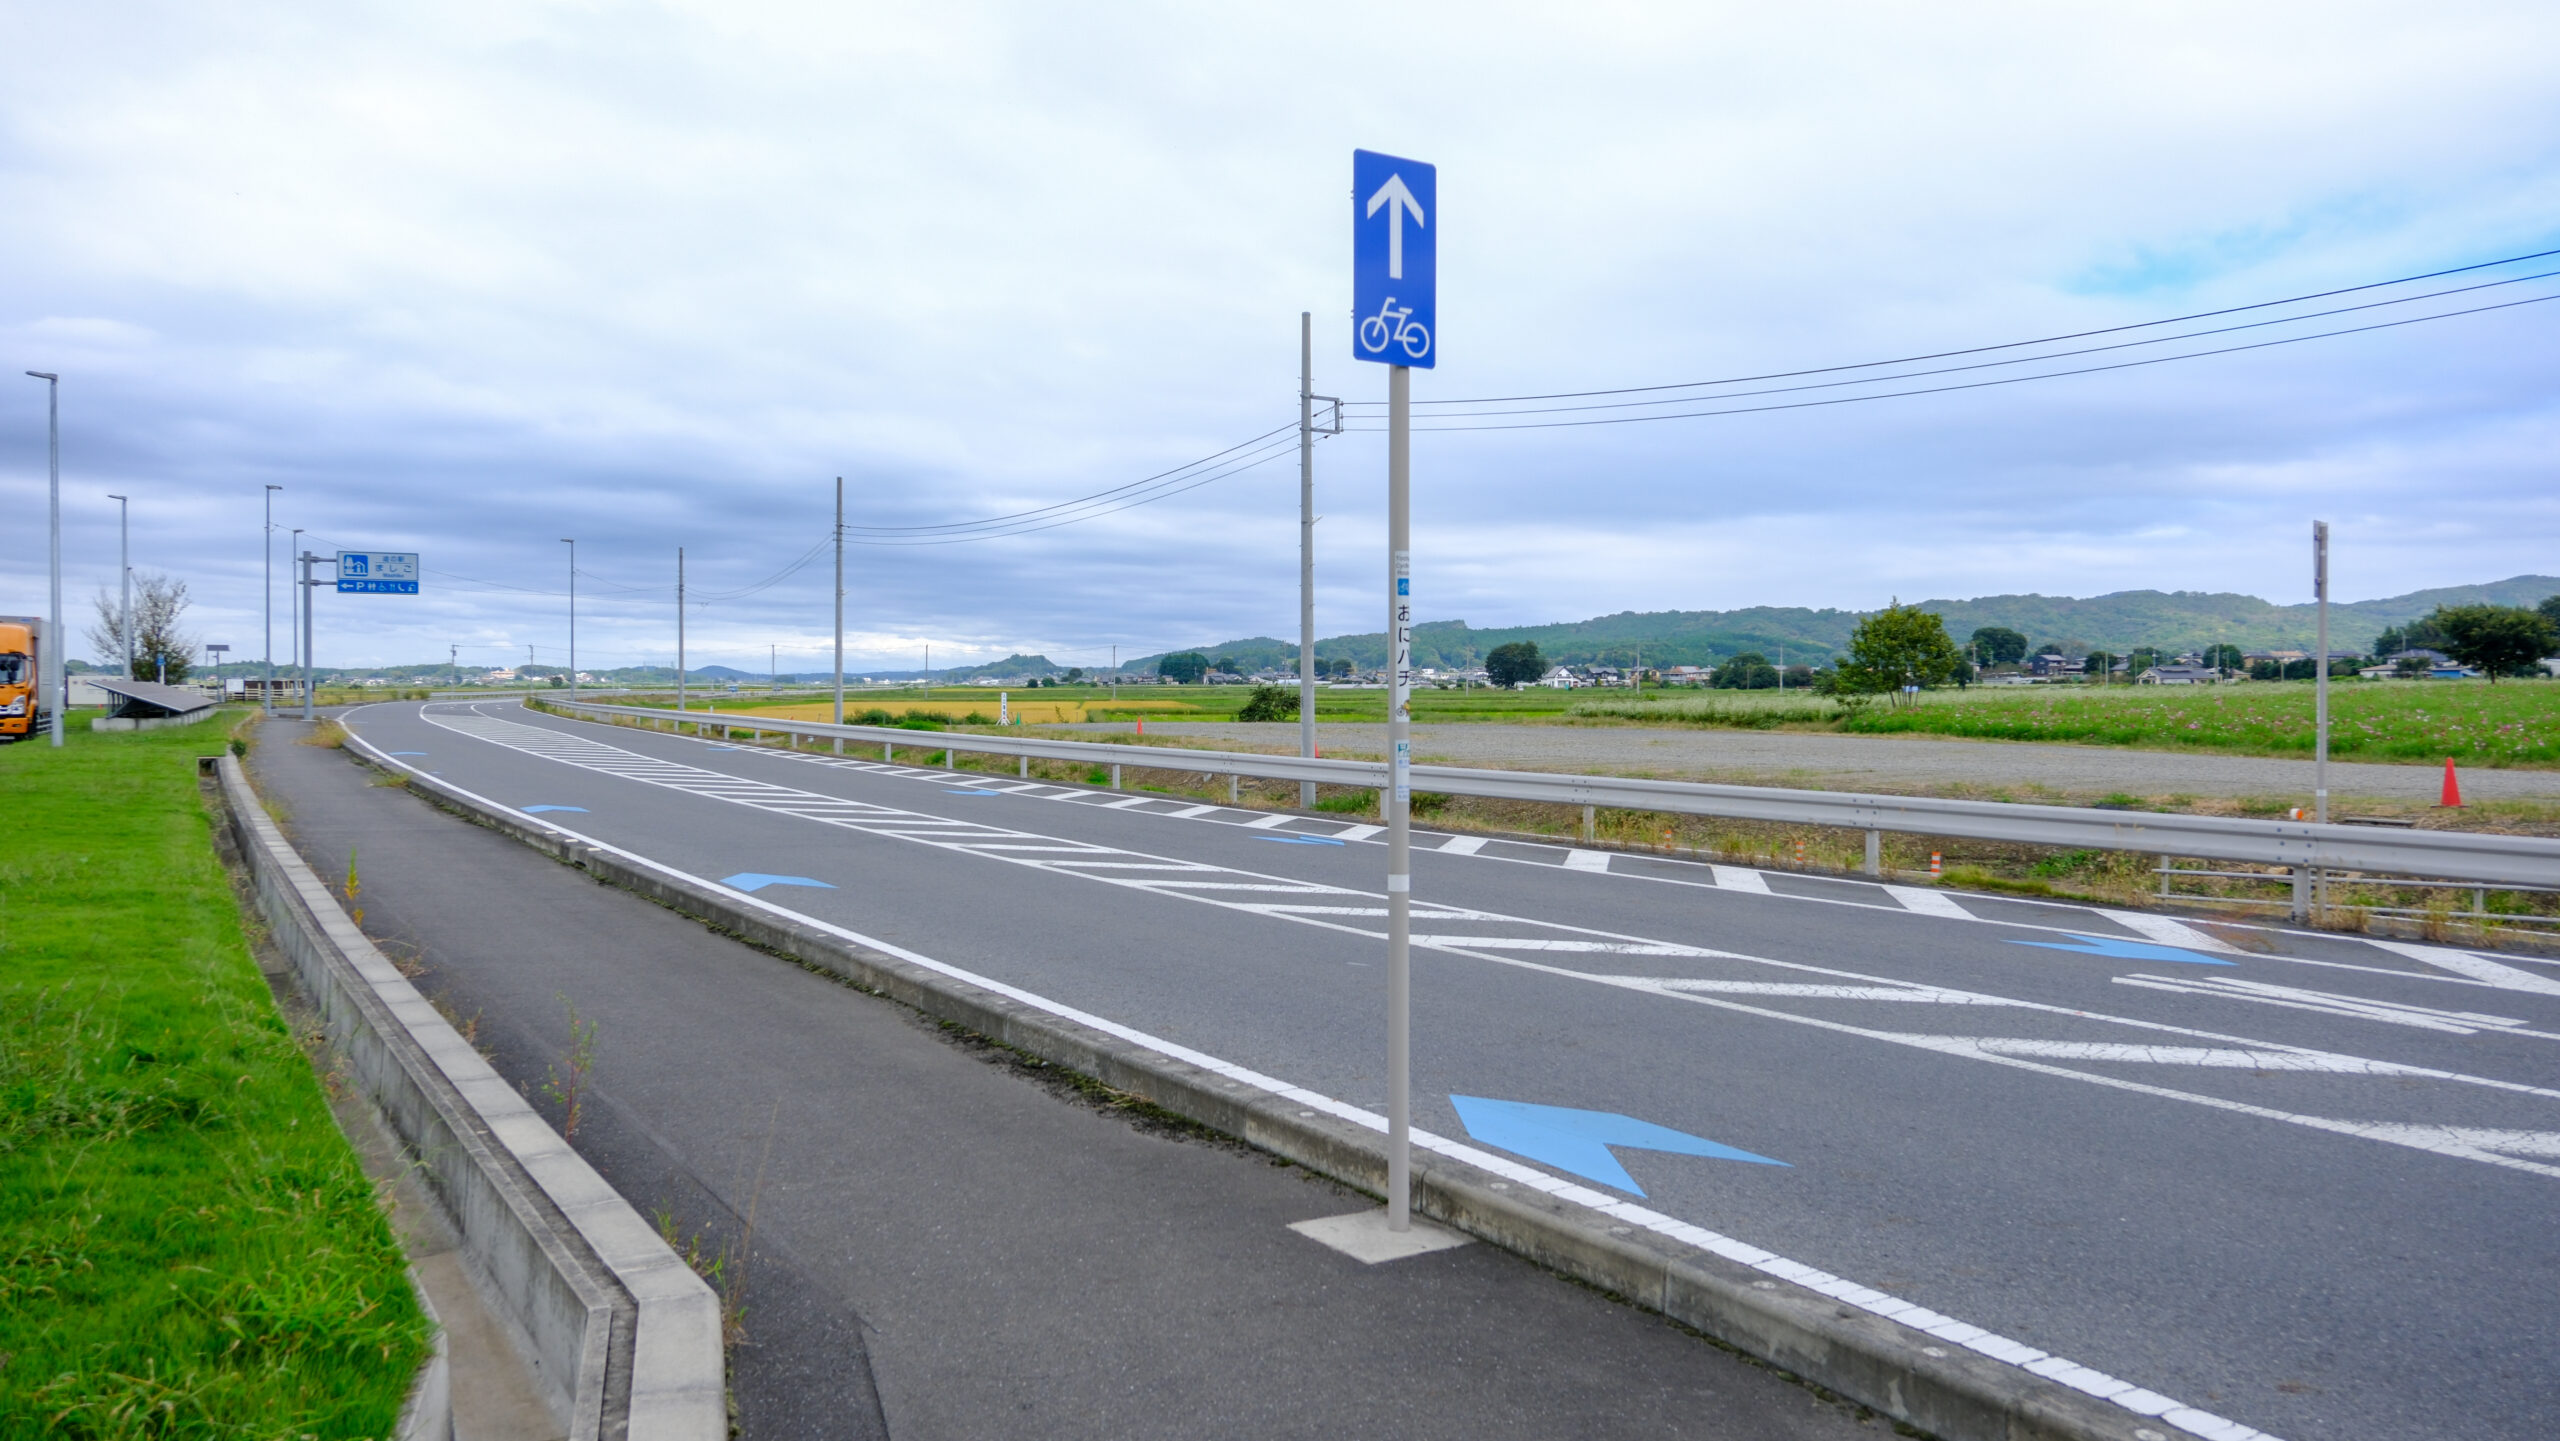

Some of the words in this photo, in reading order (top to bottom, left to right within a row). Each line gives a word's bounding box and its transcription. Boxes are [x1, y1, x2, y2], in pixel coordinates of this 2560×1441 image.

[375, 564, 412, 573] ましこ
[356, 582, 365, 590] P
[1397, 604, 1410, 687] おにハチ
